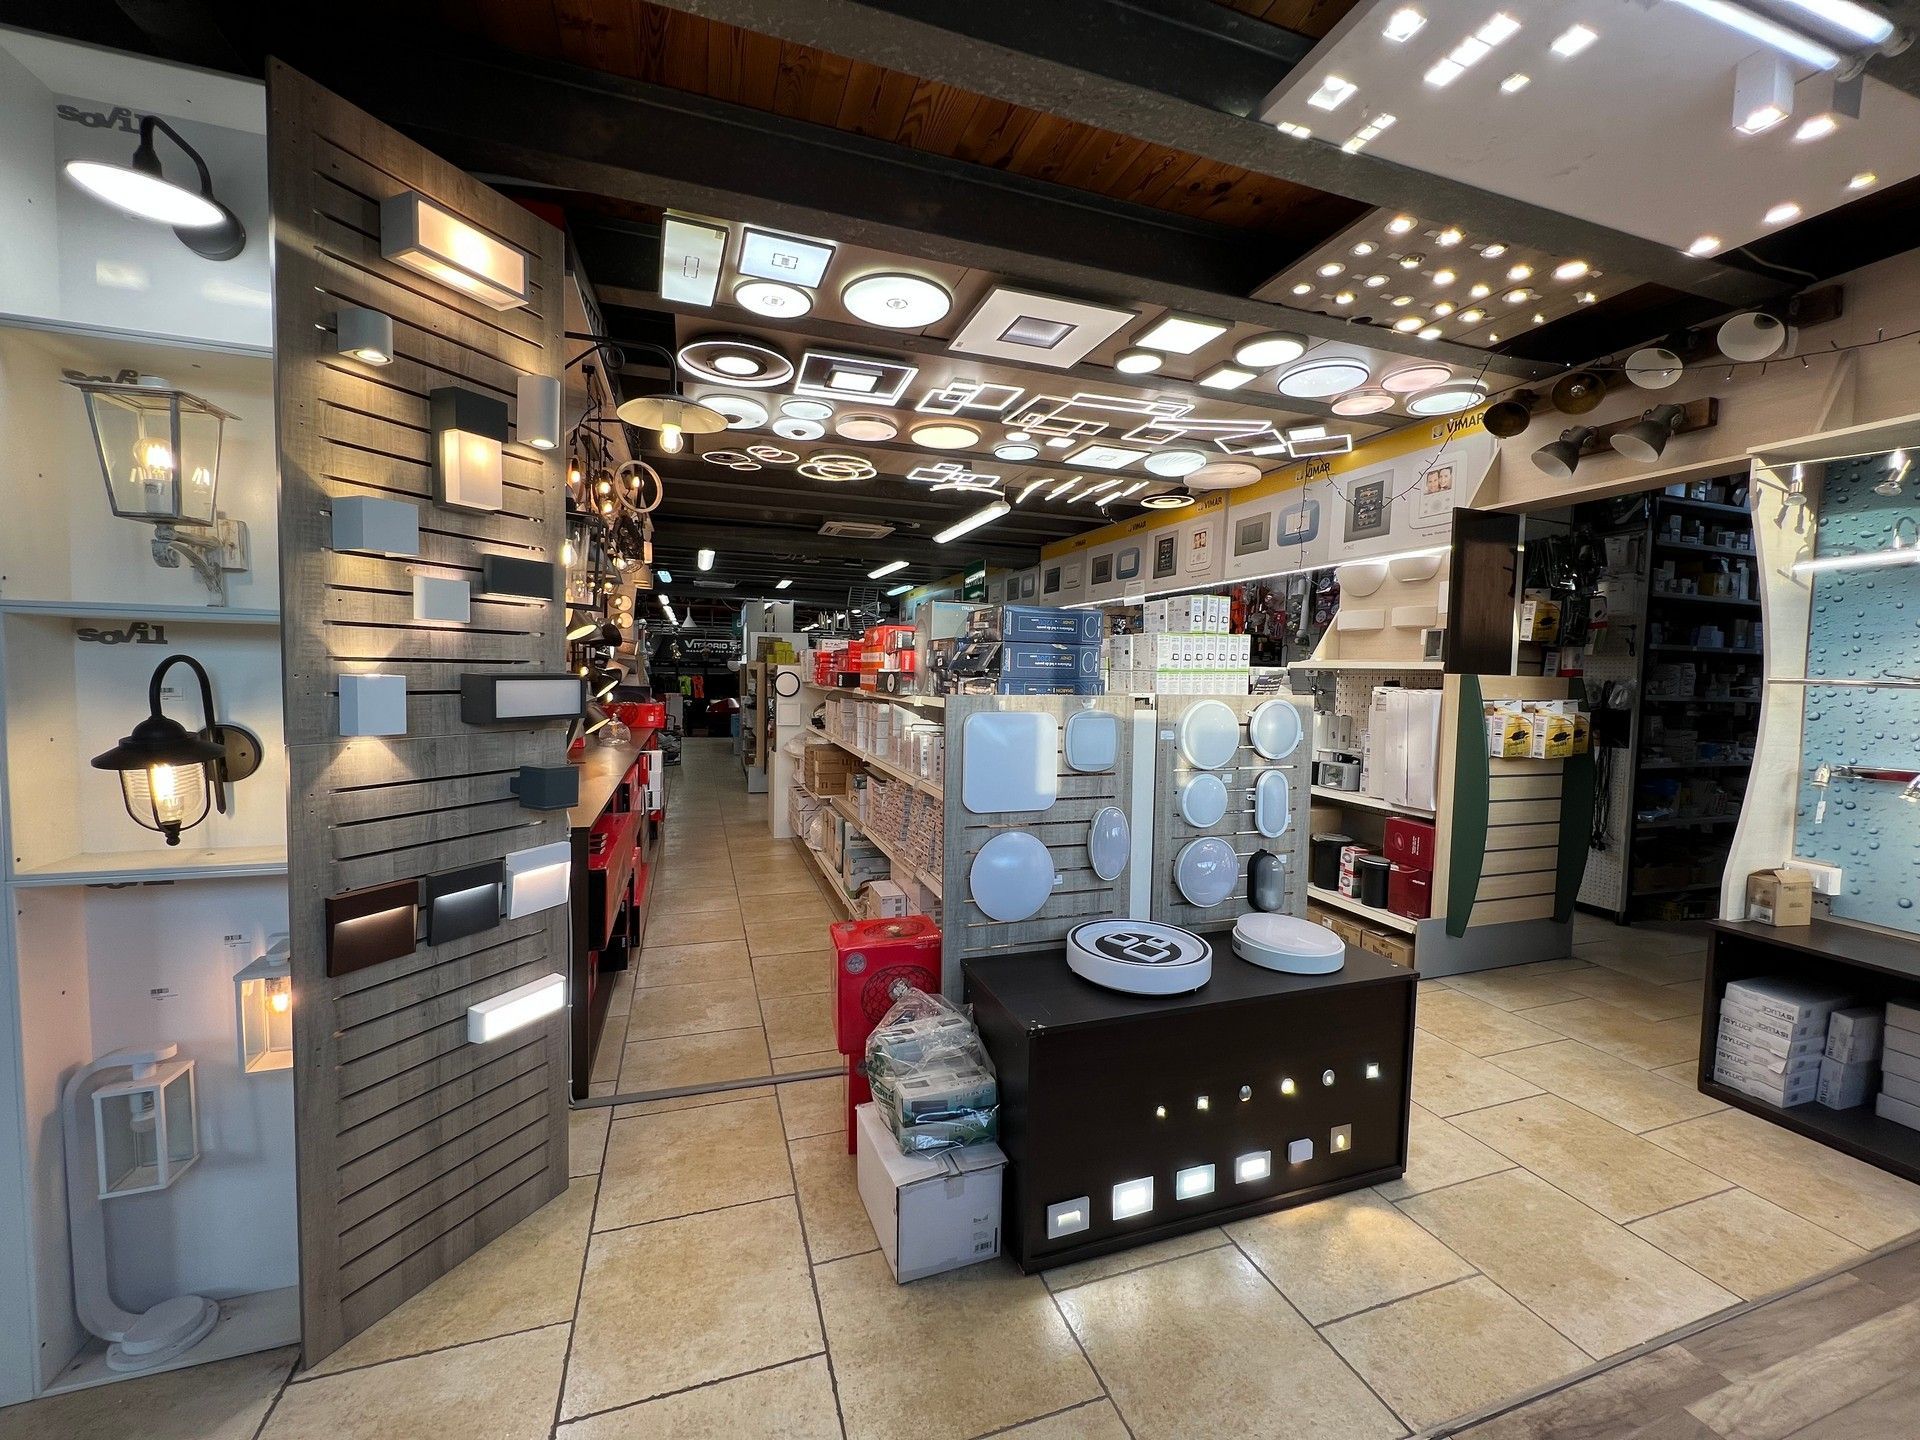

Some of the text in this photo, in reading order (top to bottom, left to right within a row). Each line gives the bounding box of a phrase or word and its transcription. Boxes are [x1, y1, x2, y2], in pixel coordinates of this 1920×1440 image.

[1447, 412, 1485, 433] VIMAR
[1306, 462, 1330, 477] VIMAR
[1204, 496, 1224, 510] VIMAR
[1132, 520, 1147, 531] VIMAR
[1763, 1005, 1794, 1021] ISYLUCE
[1723, 1016, 1753, 1033] ISYLUCE
[1759, 1022, 1789, 1038] ISYLUCE
[1720, 1034, 1751, 1049] ISYLUCE
[1718, 1051, 1749, 1067] ISYLUCE
[1717, 1067, 1747, 1083] ISYLUCE
